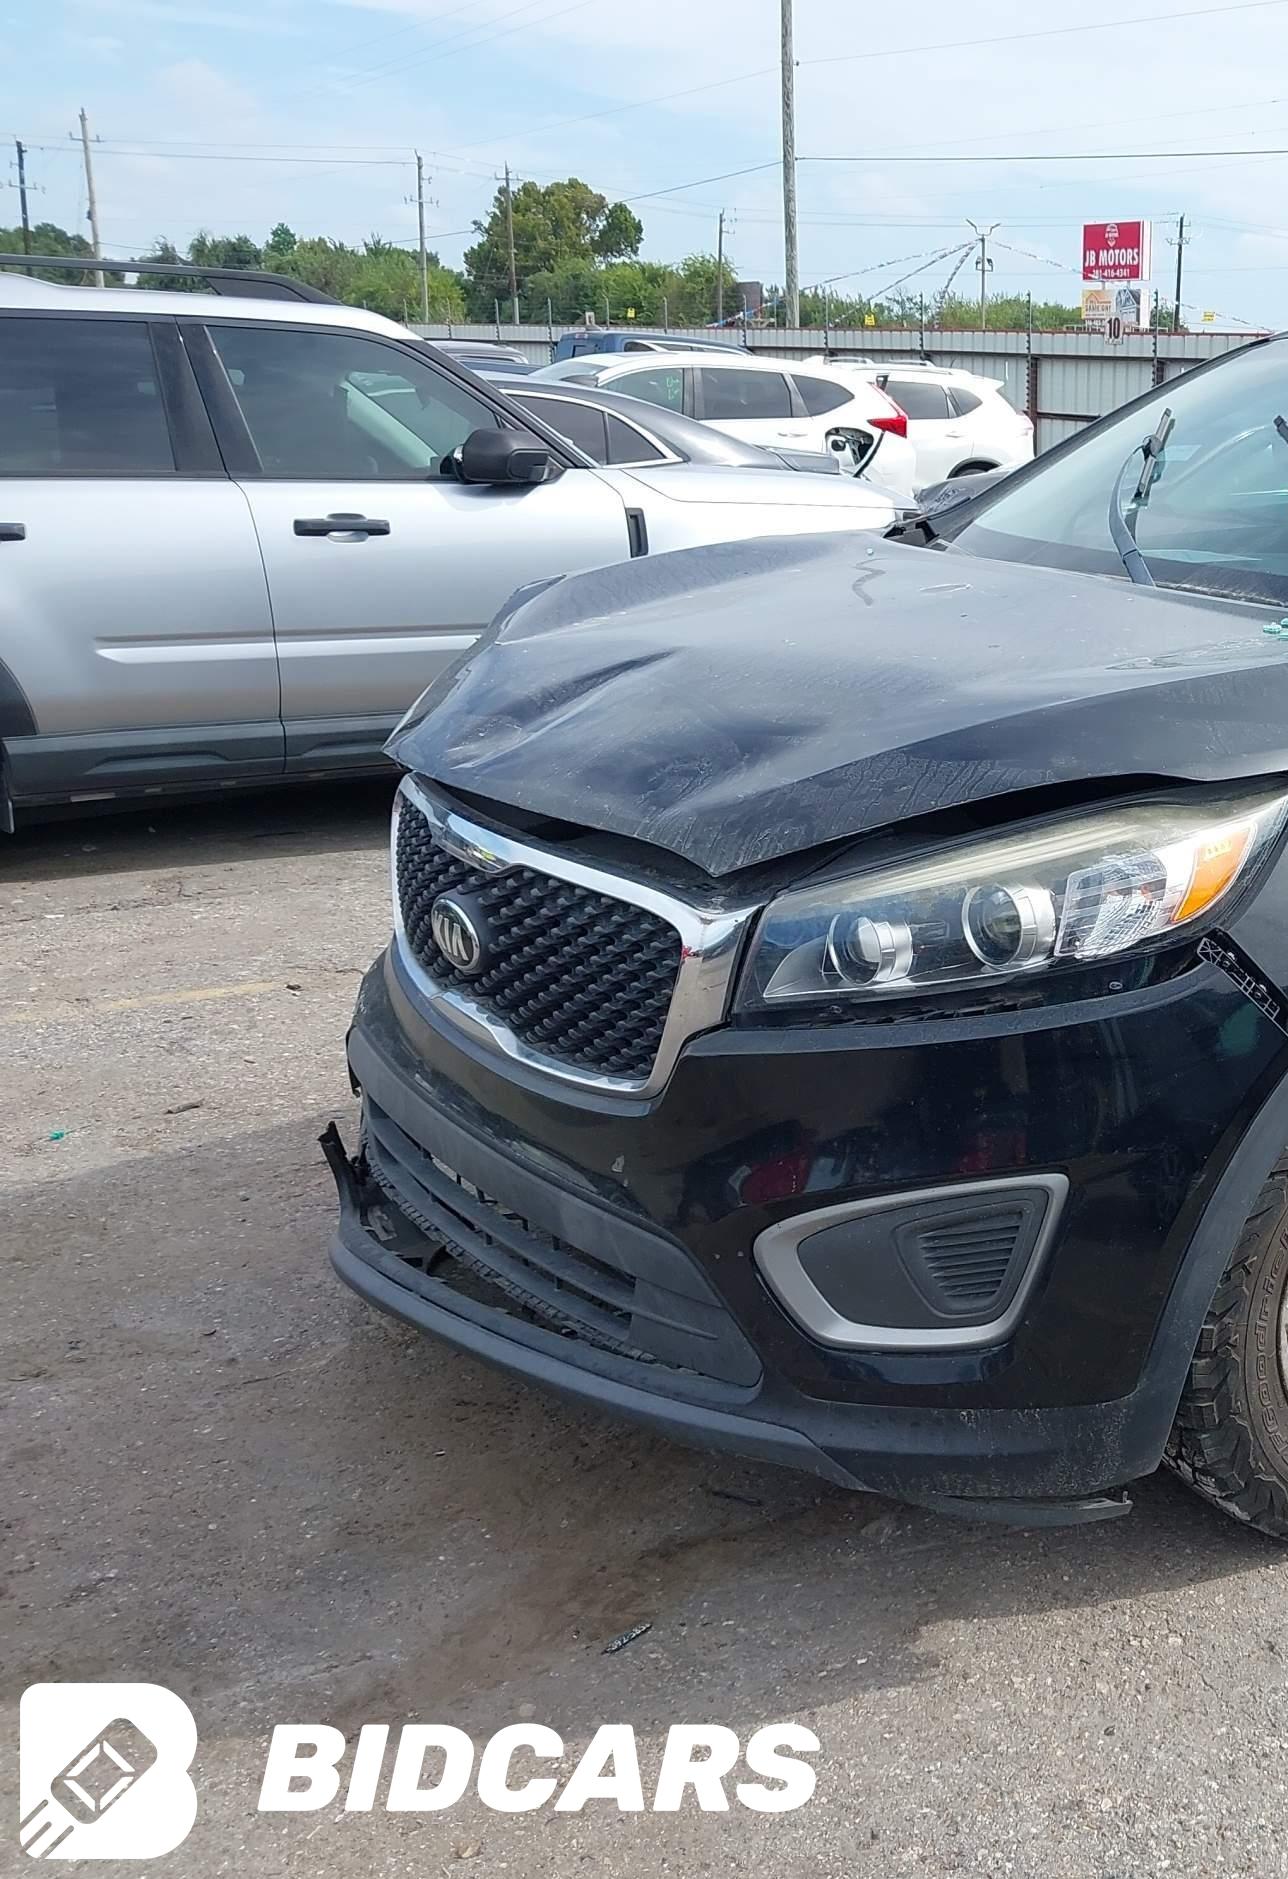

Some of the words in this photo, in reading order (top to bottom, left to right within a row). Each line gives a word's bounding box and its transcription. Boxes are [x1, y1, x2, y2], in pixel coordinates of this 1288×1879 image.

[1085, 249, 1096, 267] JB
[1098, 247, 1139, 266] MOTORS
[1107, 317, 1121, 339] 10
[433, 910, 470, 961] KIA
